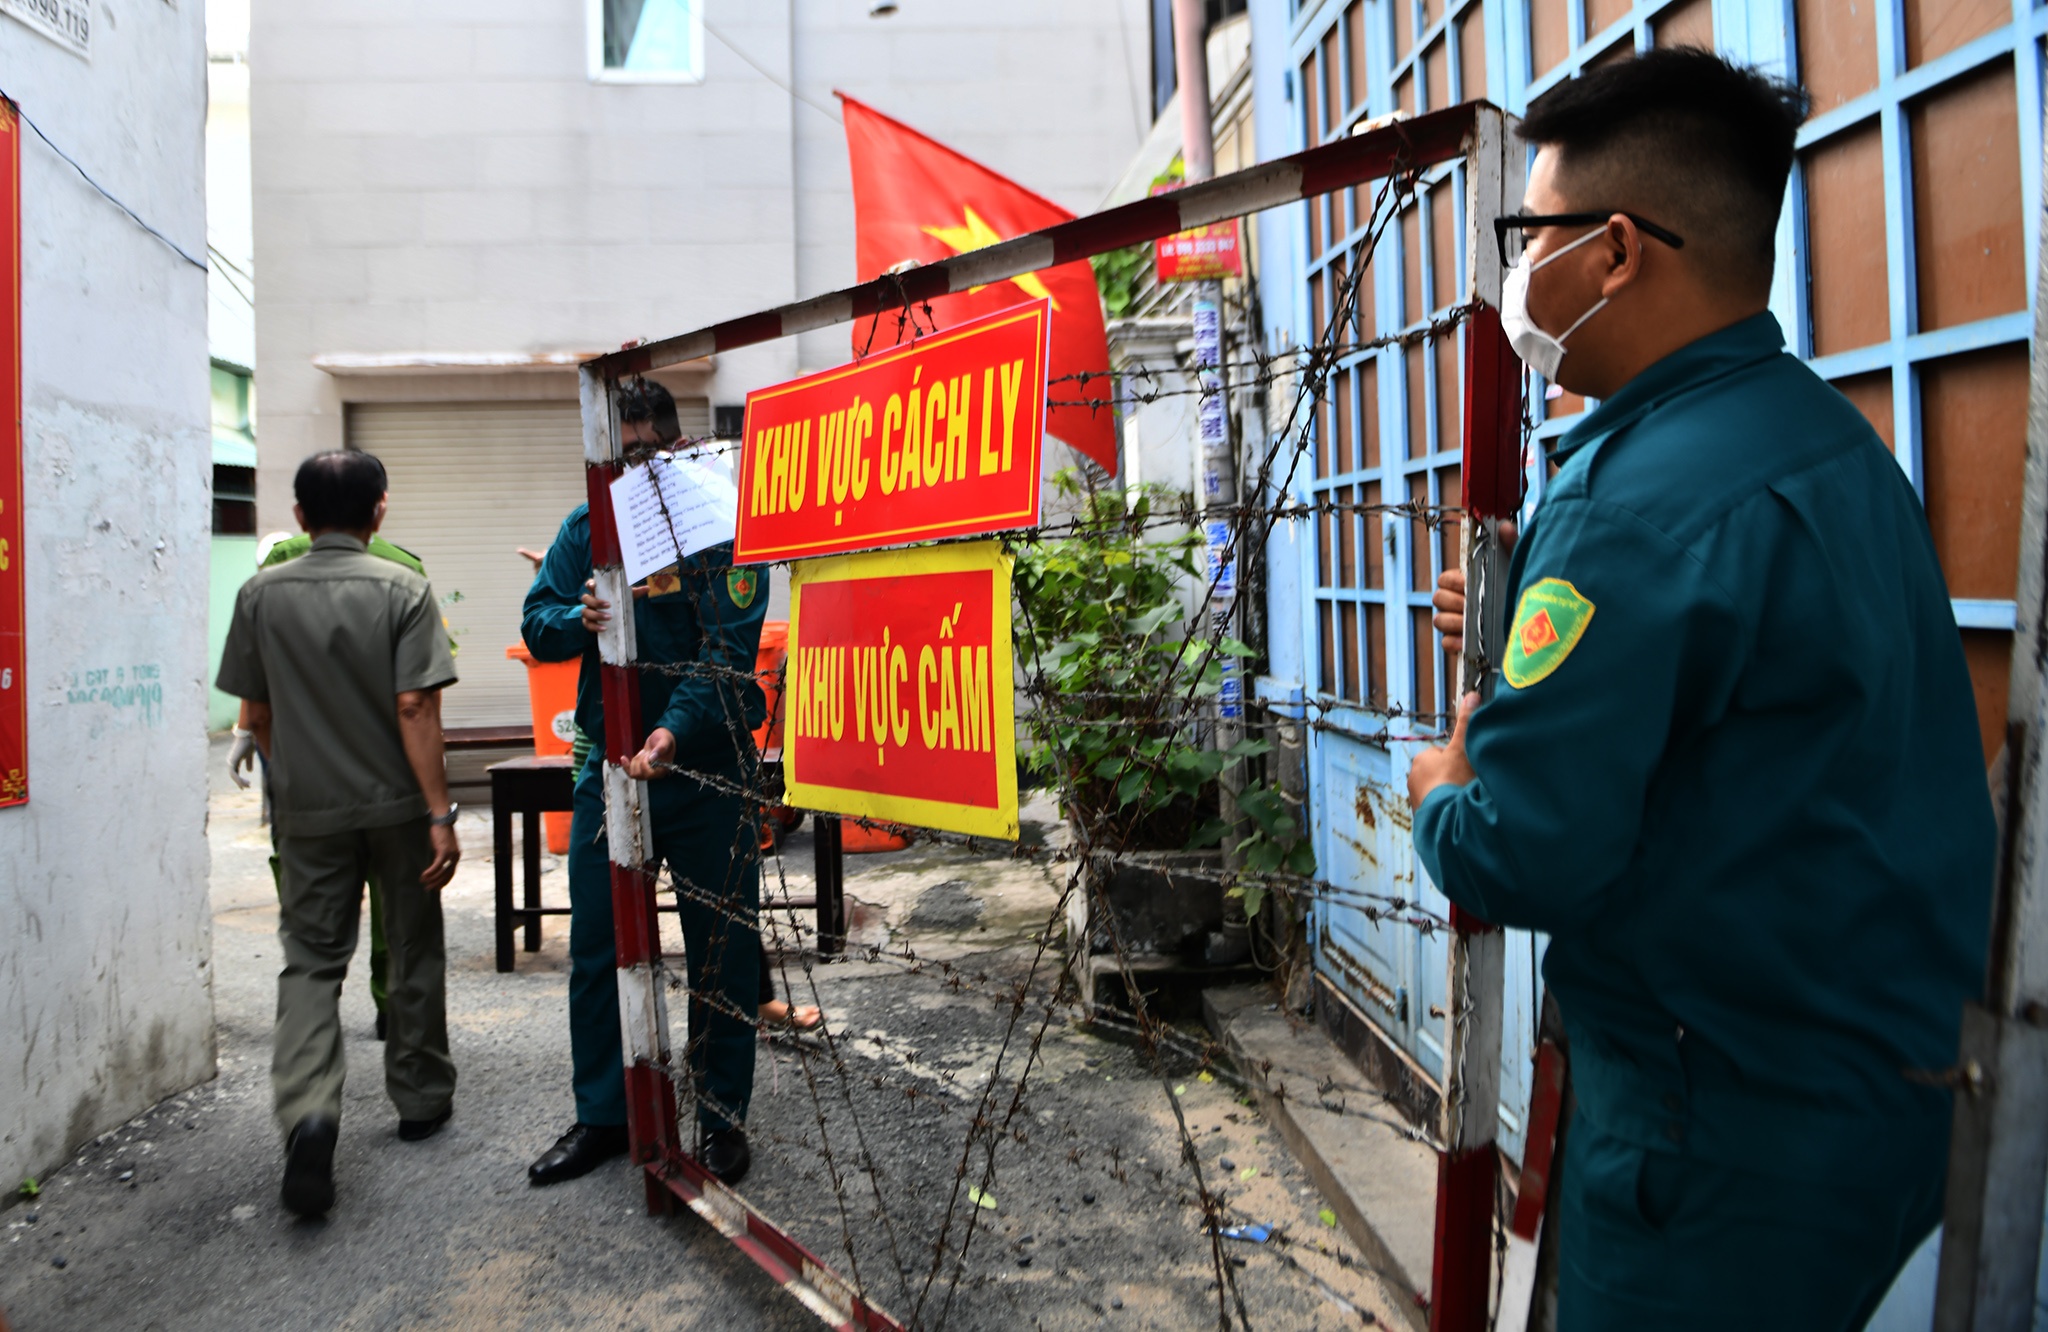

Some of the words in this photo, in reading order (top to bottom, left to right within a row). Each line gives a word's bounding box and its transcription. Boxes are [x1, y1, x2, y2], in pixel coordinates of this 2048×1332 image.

[751, 419, 811, 517] KHU
[817, 395, 873, 526] VỰC
[879, 365, 971, 495] CÁCH
[979, 358, 1025, 477] LY
[798, 646, 845, 741] KHU
[853, 625, 909, 766] VỰC
[918, 602, 991, 752] CẤM
